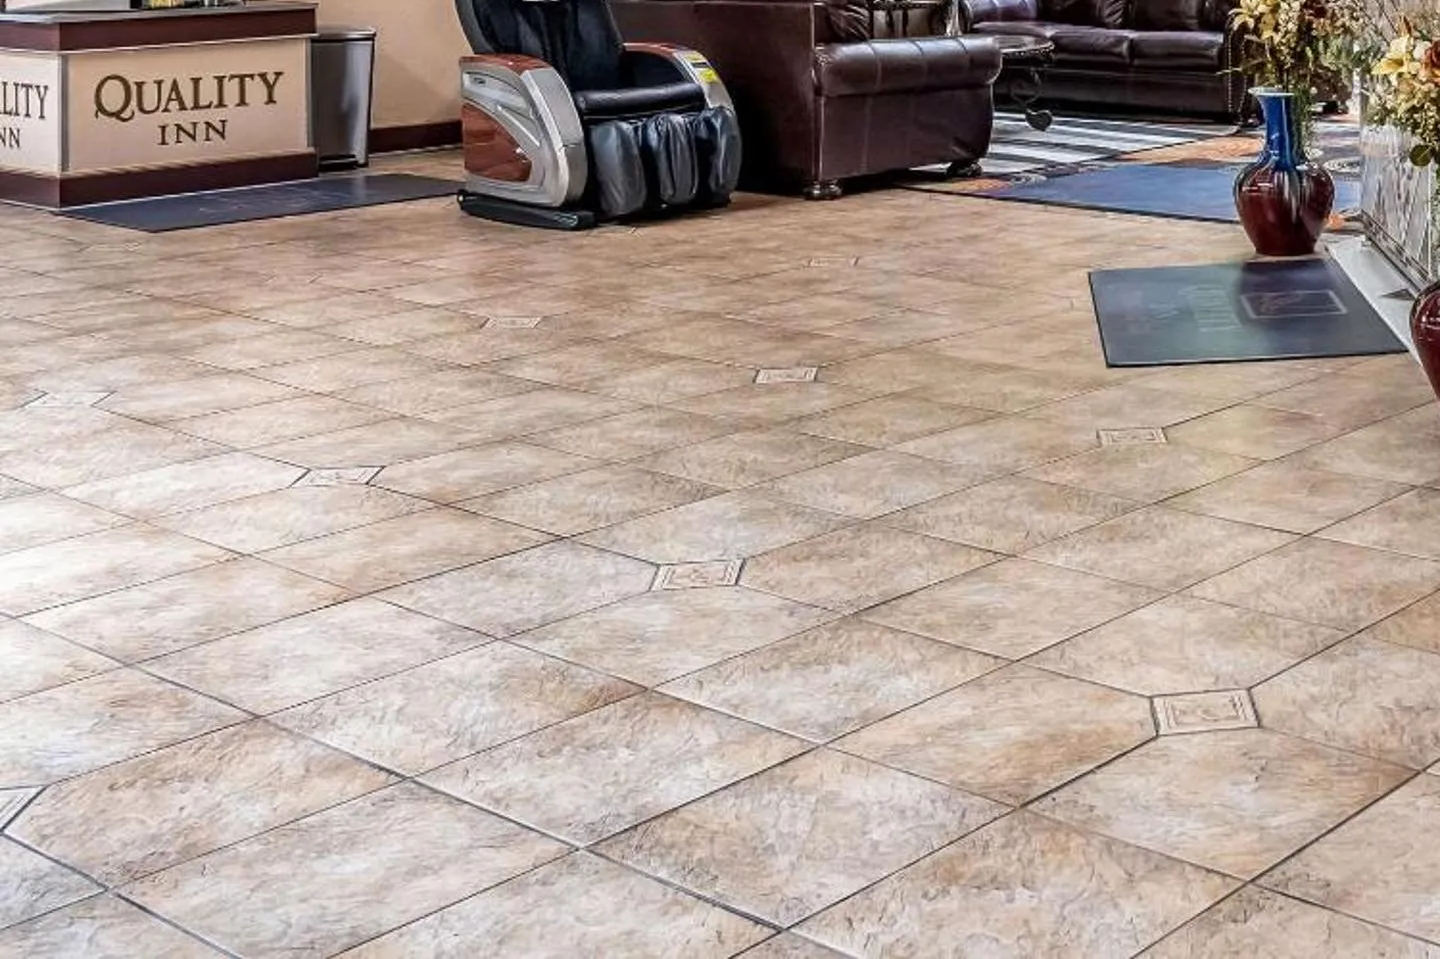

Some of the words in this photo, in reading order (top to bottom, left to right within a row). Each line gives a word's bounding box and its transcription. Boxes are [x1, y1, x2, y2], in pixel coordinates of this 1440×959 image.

[0, 80, 49, 120] LITY
[94, 71, 284, 123] QUALITY
[157, 119, 228, 146] INN
